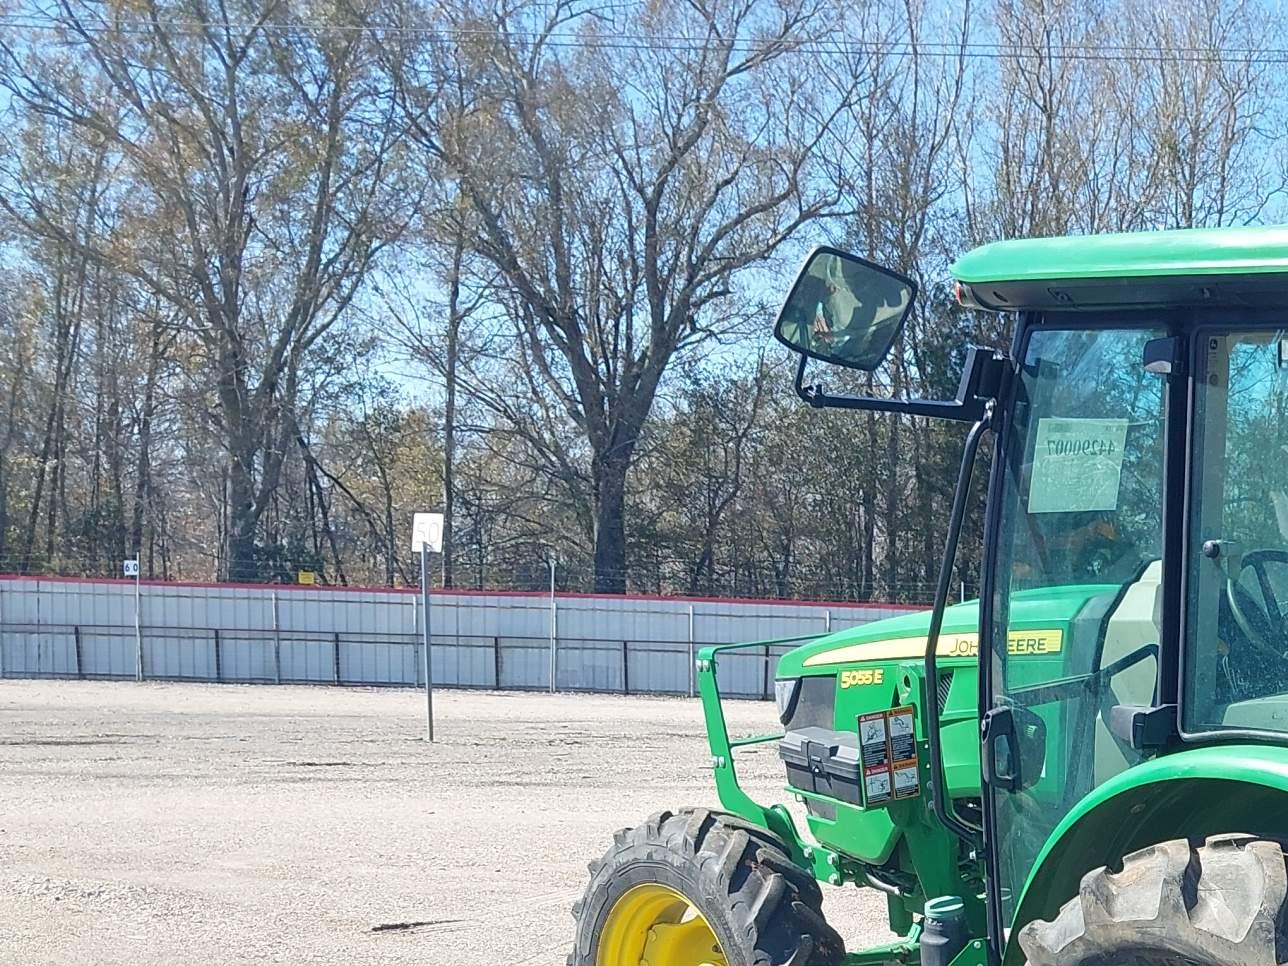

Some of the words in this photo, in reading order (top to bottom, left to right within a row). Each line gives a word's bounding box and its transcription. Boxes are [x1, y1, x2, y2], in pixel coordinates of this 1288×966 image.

[417, 522, 440, 544] 50
[950, 638, 979, 653] JOH
[1008, 638, 1047, 652] EERE
